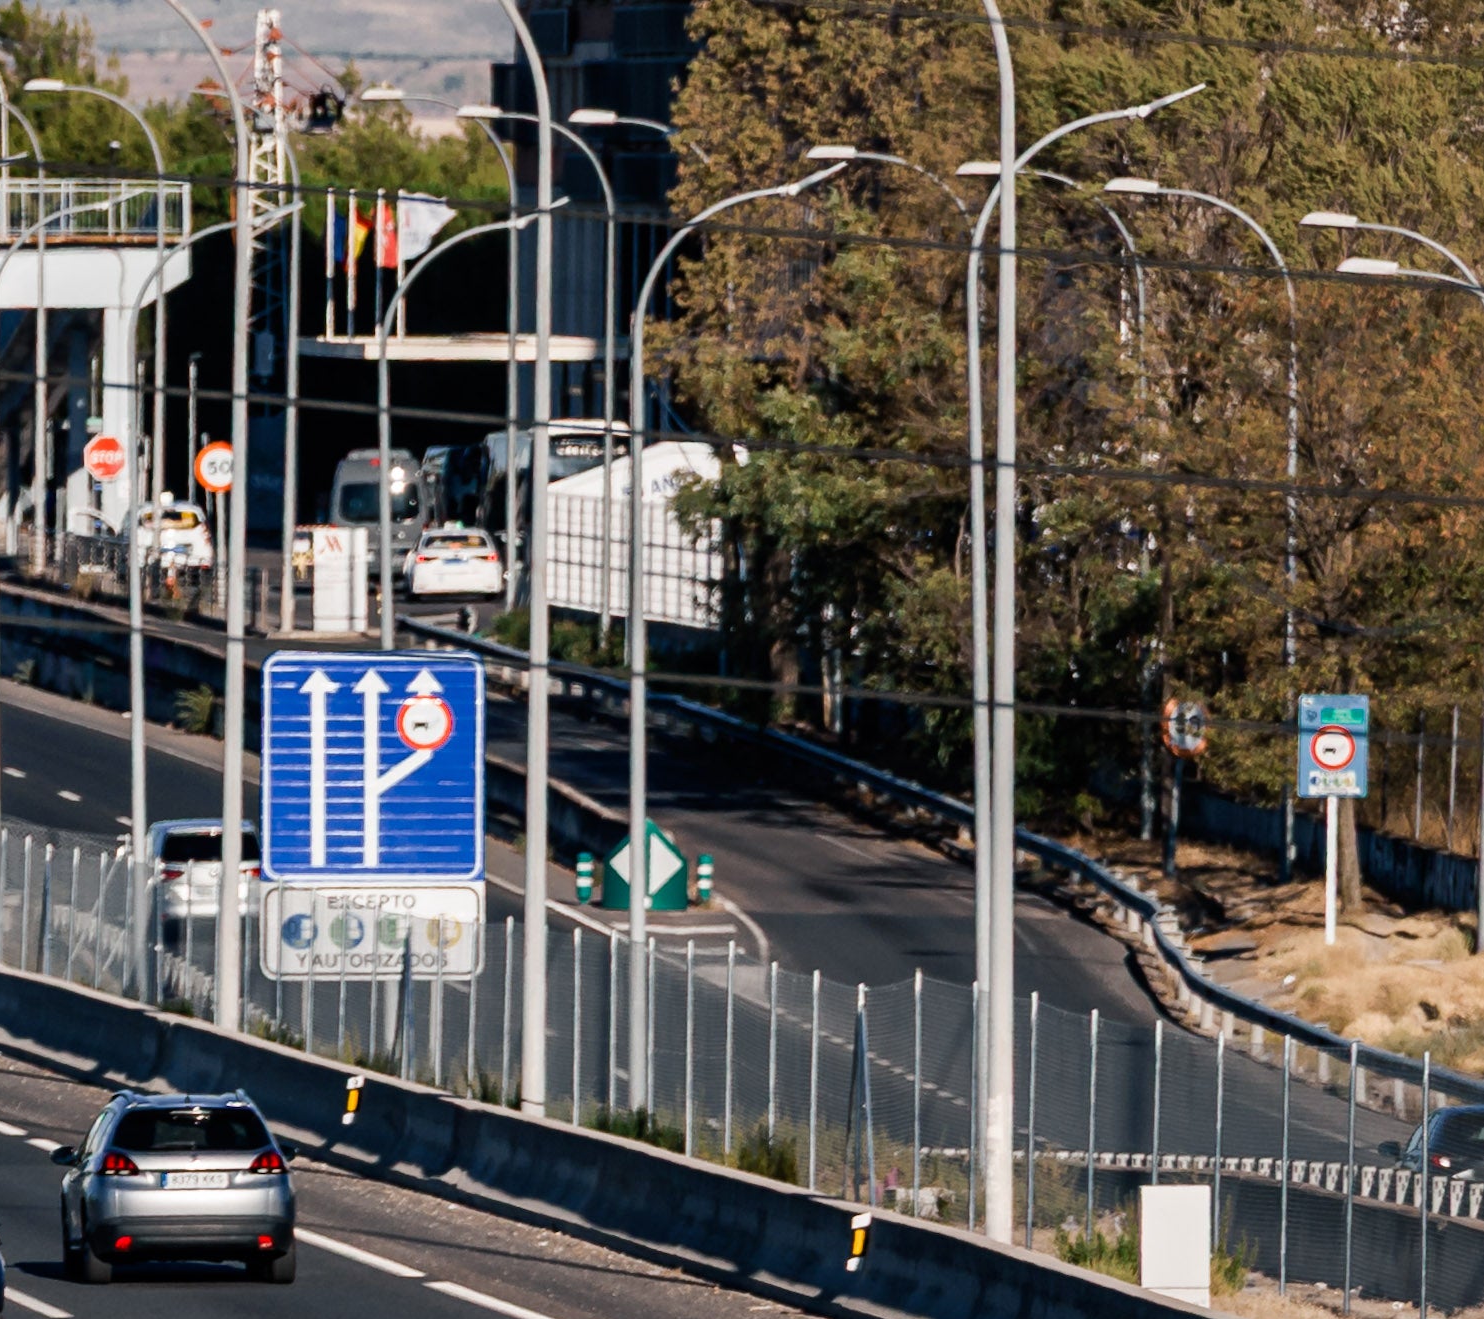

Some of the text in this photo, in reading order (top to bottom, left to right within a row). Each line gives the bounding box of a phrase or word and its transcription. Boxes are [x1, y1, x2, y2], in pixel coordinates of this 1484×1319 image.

[90, 451, 124, 464] STOP
[207, 460, 234, 476] 50
[327, 894, 417, 910] EXCEPTO
